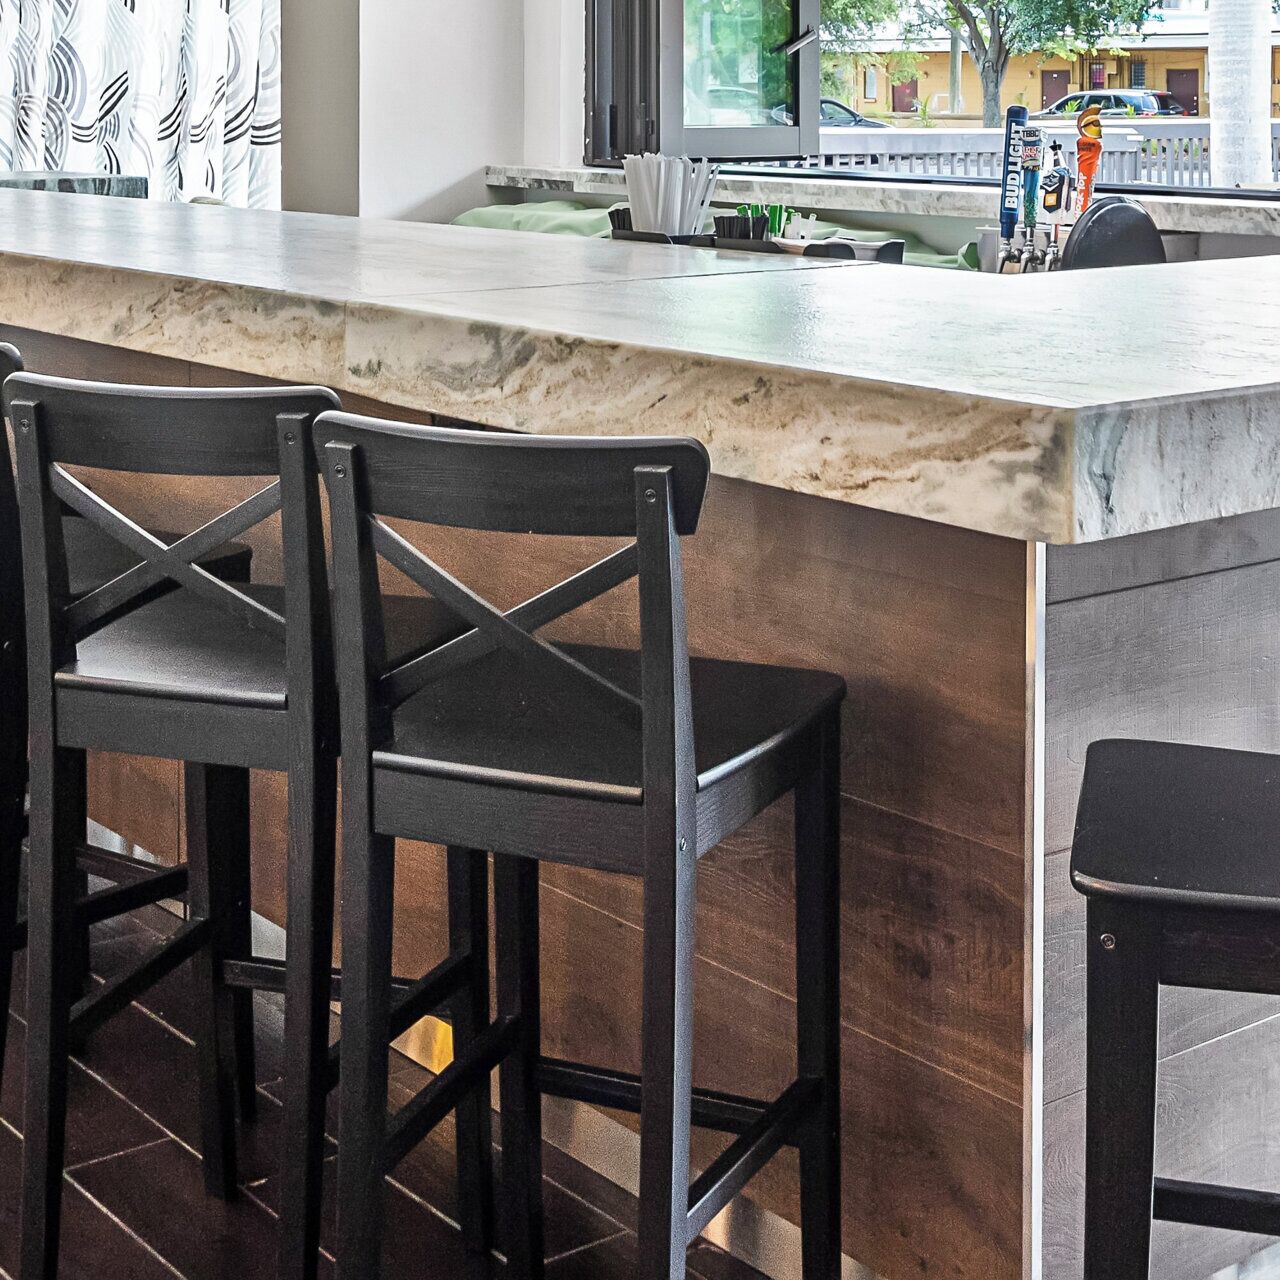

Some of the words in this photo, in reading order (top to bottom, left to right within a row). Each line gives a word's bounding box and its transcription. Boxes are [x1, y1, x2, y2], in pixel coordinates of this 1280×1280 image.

[1008, 122, 1025, 171] LIGHT
[1021, 128, 1040, 140] TBBC
[1004, 172, 1020, 209] BUD
[1077, 171, 1088, 191] TOP
